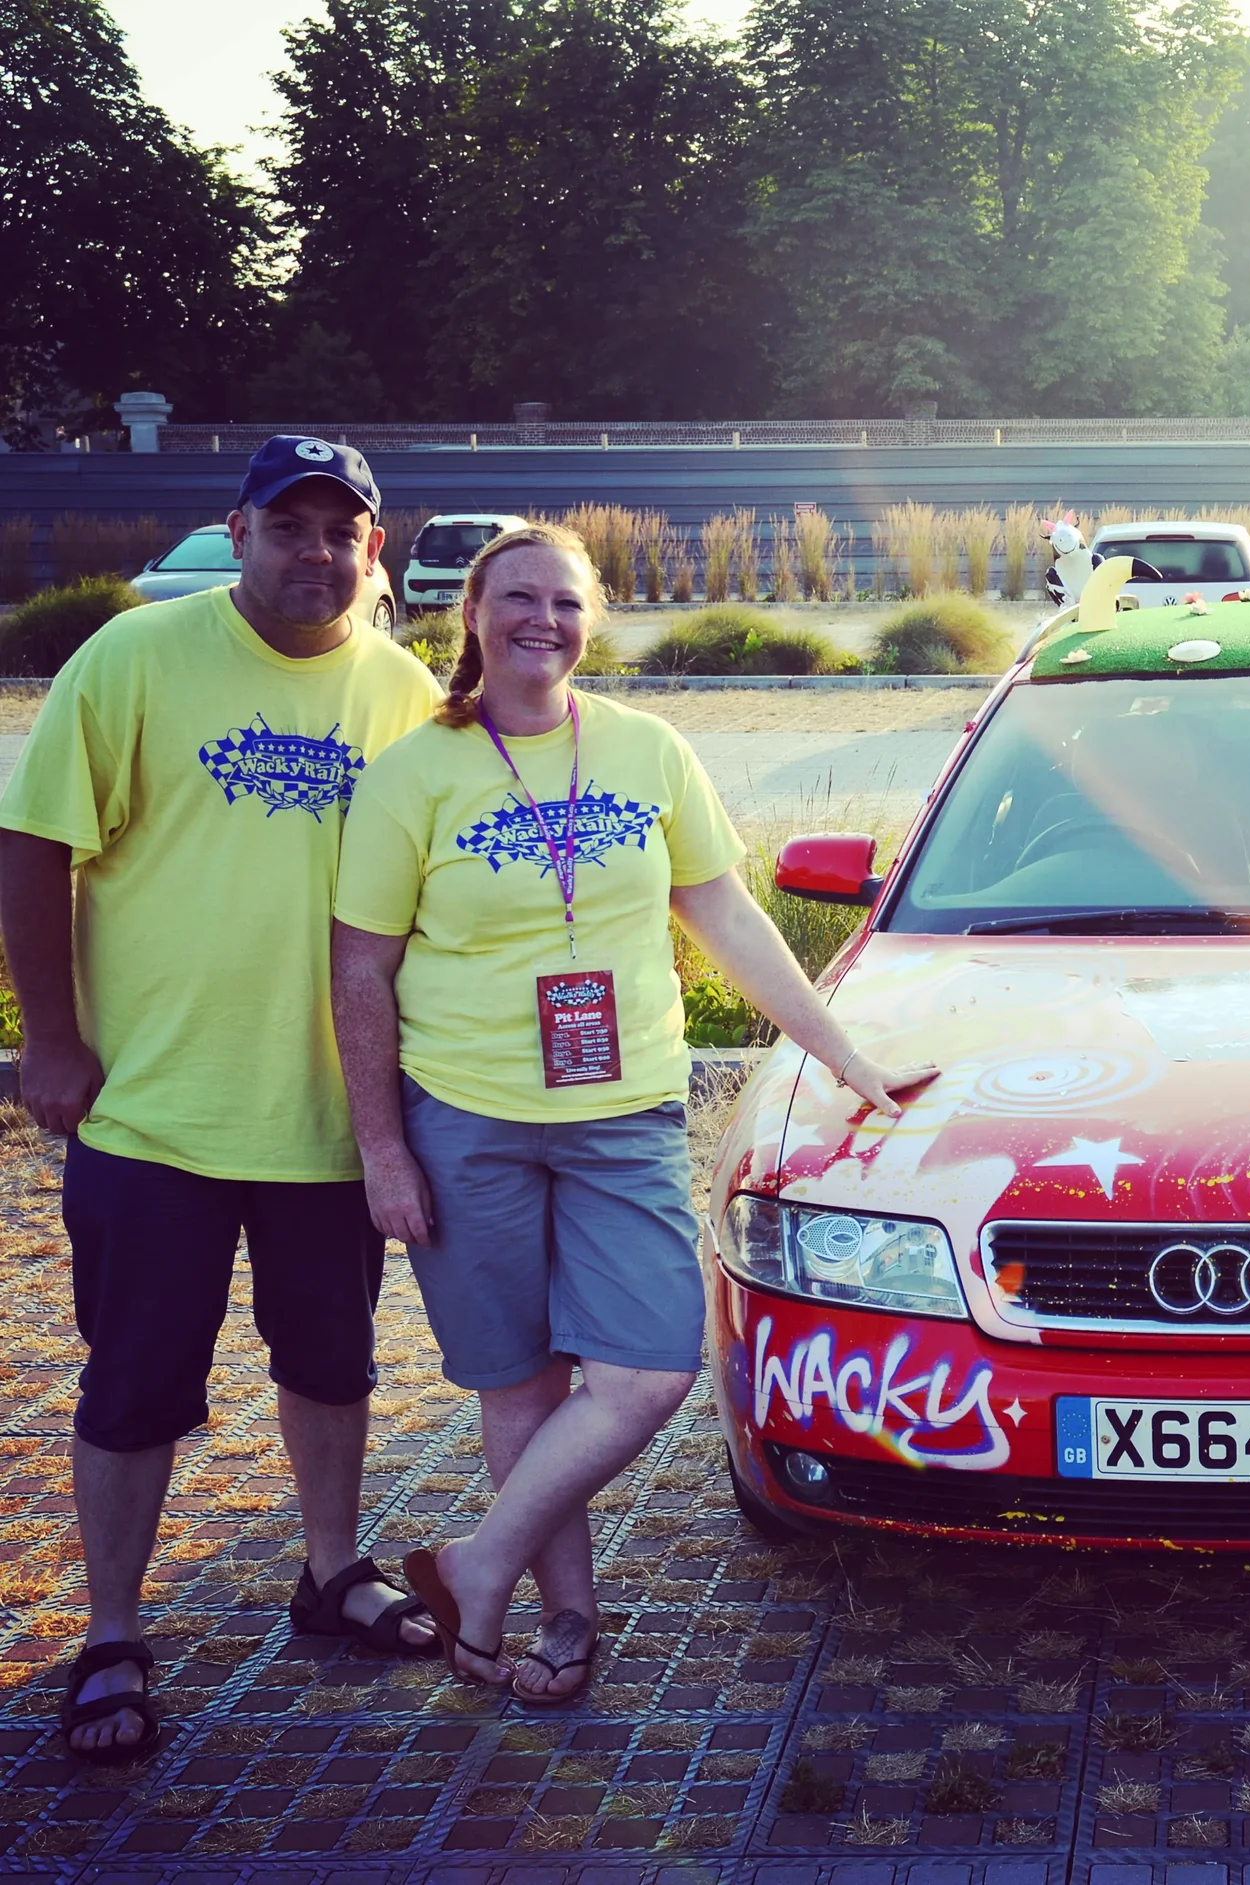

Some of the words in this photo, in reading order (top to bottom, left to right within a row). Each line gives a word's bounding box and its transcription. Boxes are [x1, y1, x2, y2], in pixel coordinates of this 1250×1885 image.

[237, 757, 302, 777] Wacky
[304, 760, 348, 784] Rall
[574, 817, 626, 834] Rally
[554, 1013, 572, 1023] Pit
[574, 1011, 602, 1021] Lane
[1064, 1448, 1087, 1463] GB
